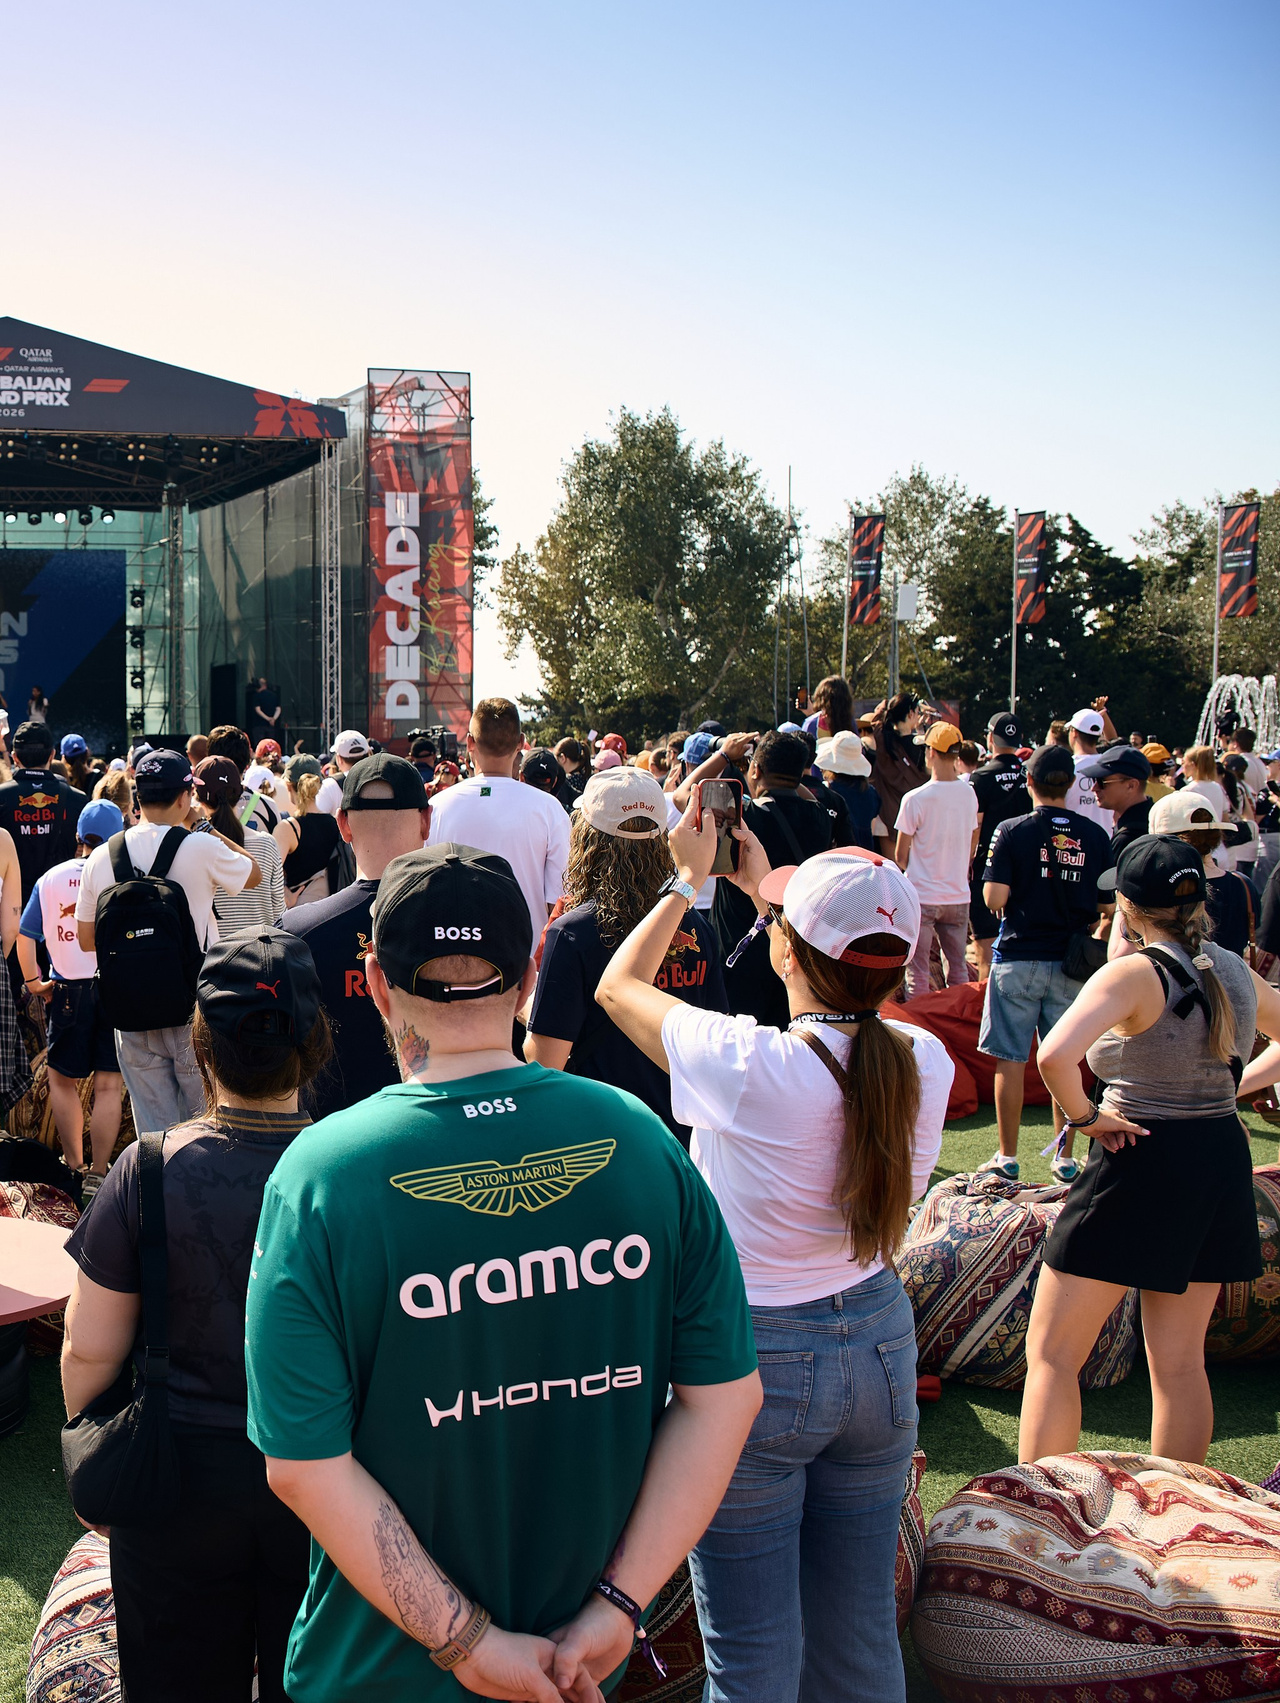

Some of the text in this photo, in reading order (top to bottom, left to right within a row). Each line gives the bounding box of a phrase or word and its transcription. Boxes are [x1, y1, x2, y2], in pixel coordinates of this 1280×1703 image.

[19, 347, 52, 358] QATAR
[4, 365, 29, 373] QATAR
[30, 366, 64, 374] AIRWAYS
[22, 391, 70, 406] PRIX
[408, 536, 470, 636] Racing
[385, 491, 421, 720] DECADE
[14, 808, 41, 821] Red
[621, 801, 655, 813] Red Bull
[20, 823, 50, 835] Mobil
[1061, 850, 1086, 867] Bull
[57, 925, 78, 942] Re
[434, 926, 483, 941] BOSS
[671, 960, 707, 988] Bull
[462, 1096, 518, 1119] BOSS
[466, 1162, 564, 1189] ASTON MARTIN
[399, 1233, 651, 1319] aramco
[471, 1364, 643, 1417] Honda
